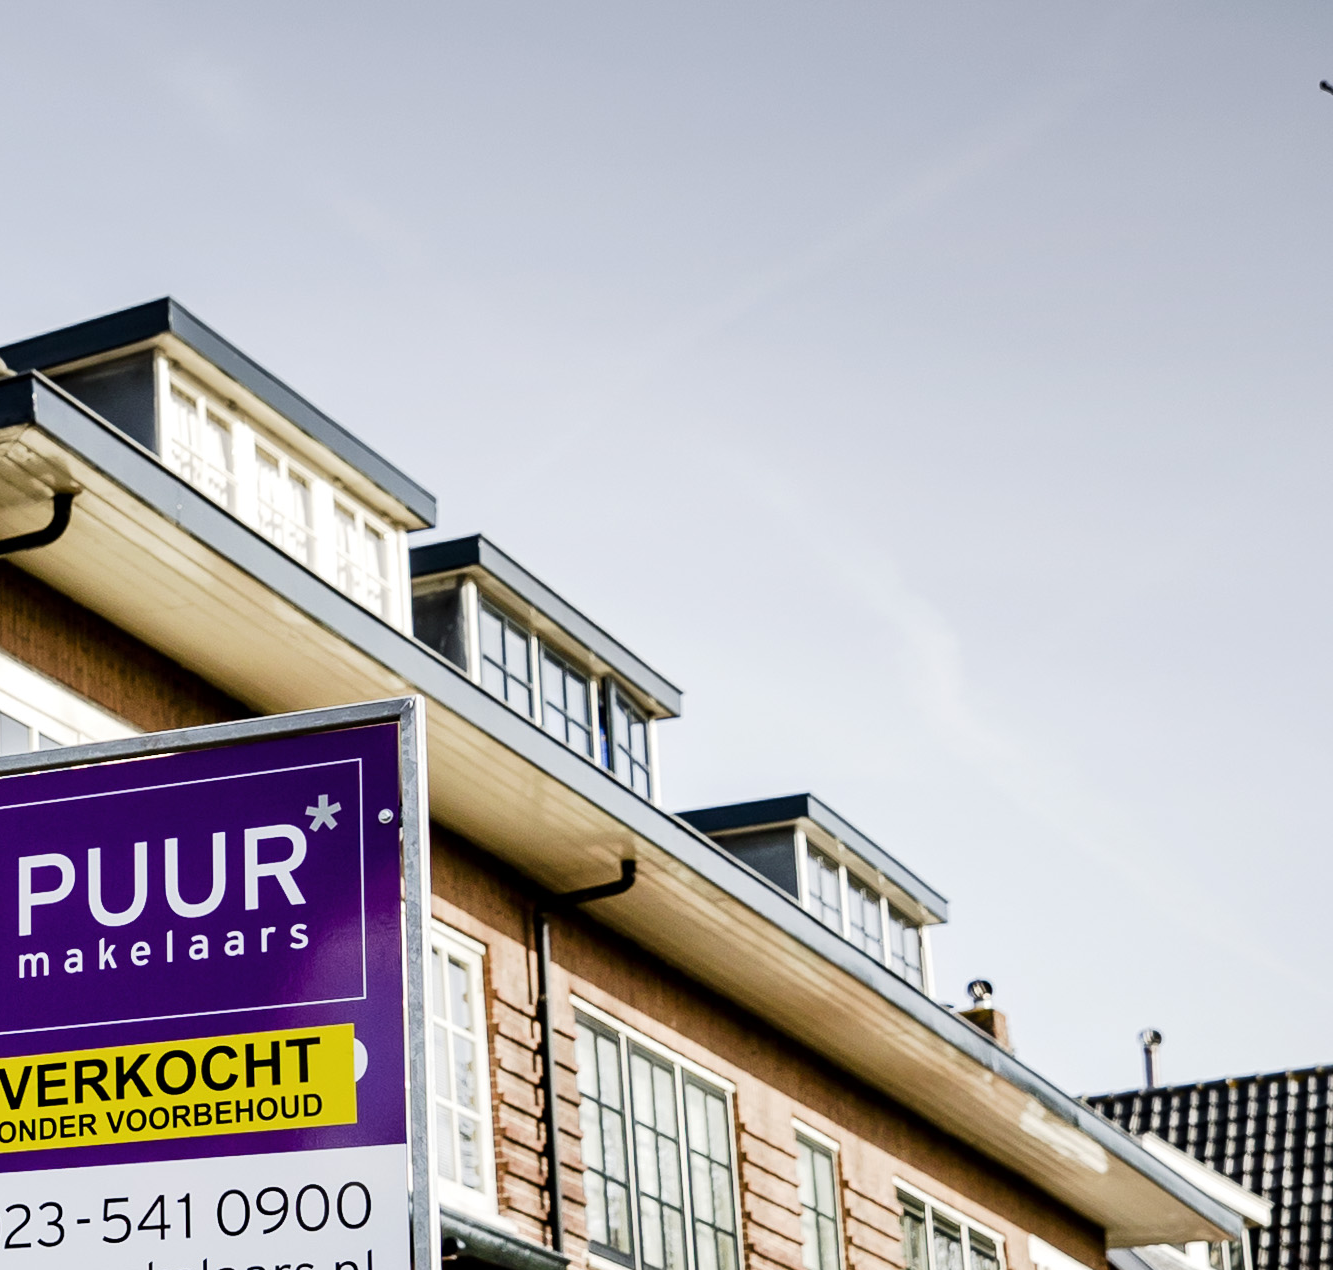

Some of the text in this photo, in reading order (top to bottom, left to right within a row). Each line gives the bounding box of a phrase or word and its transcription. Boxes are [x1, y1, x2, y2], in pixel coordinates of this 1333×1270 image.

[18, 923, 309, 979] makelaars
[105, 1093, 323, 1134] VOORBEHOUD
[216, 1181, 372, 1237] 0900
